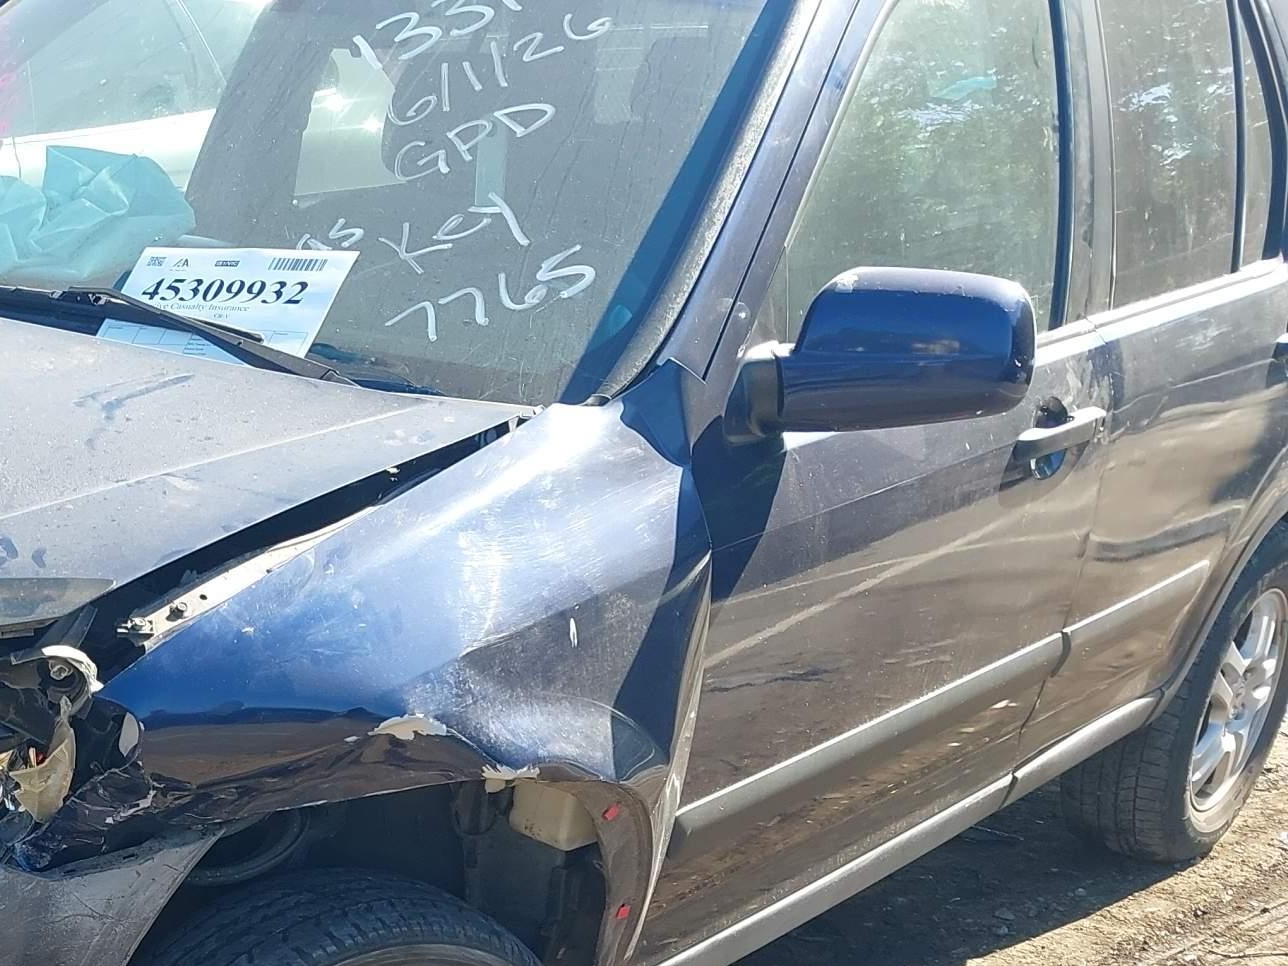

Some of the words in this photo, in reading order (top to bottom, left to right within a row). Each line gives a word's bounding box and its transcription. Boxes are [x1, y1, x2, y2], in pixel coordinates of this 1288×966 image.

[395, 103, 556, 181] GPD
[141, 278, 309, 304] 45309932
[170, 302, 205, 312] Casualty
[208, 303, 252, 312] Insurance
[385, 244, 597, 342] 7765
